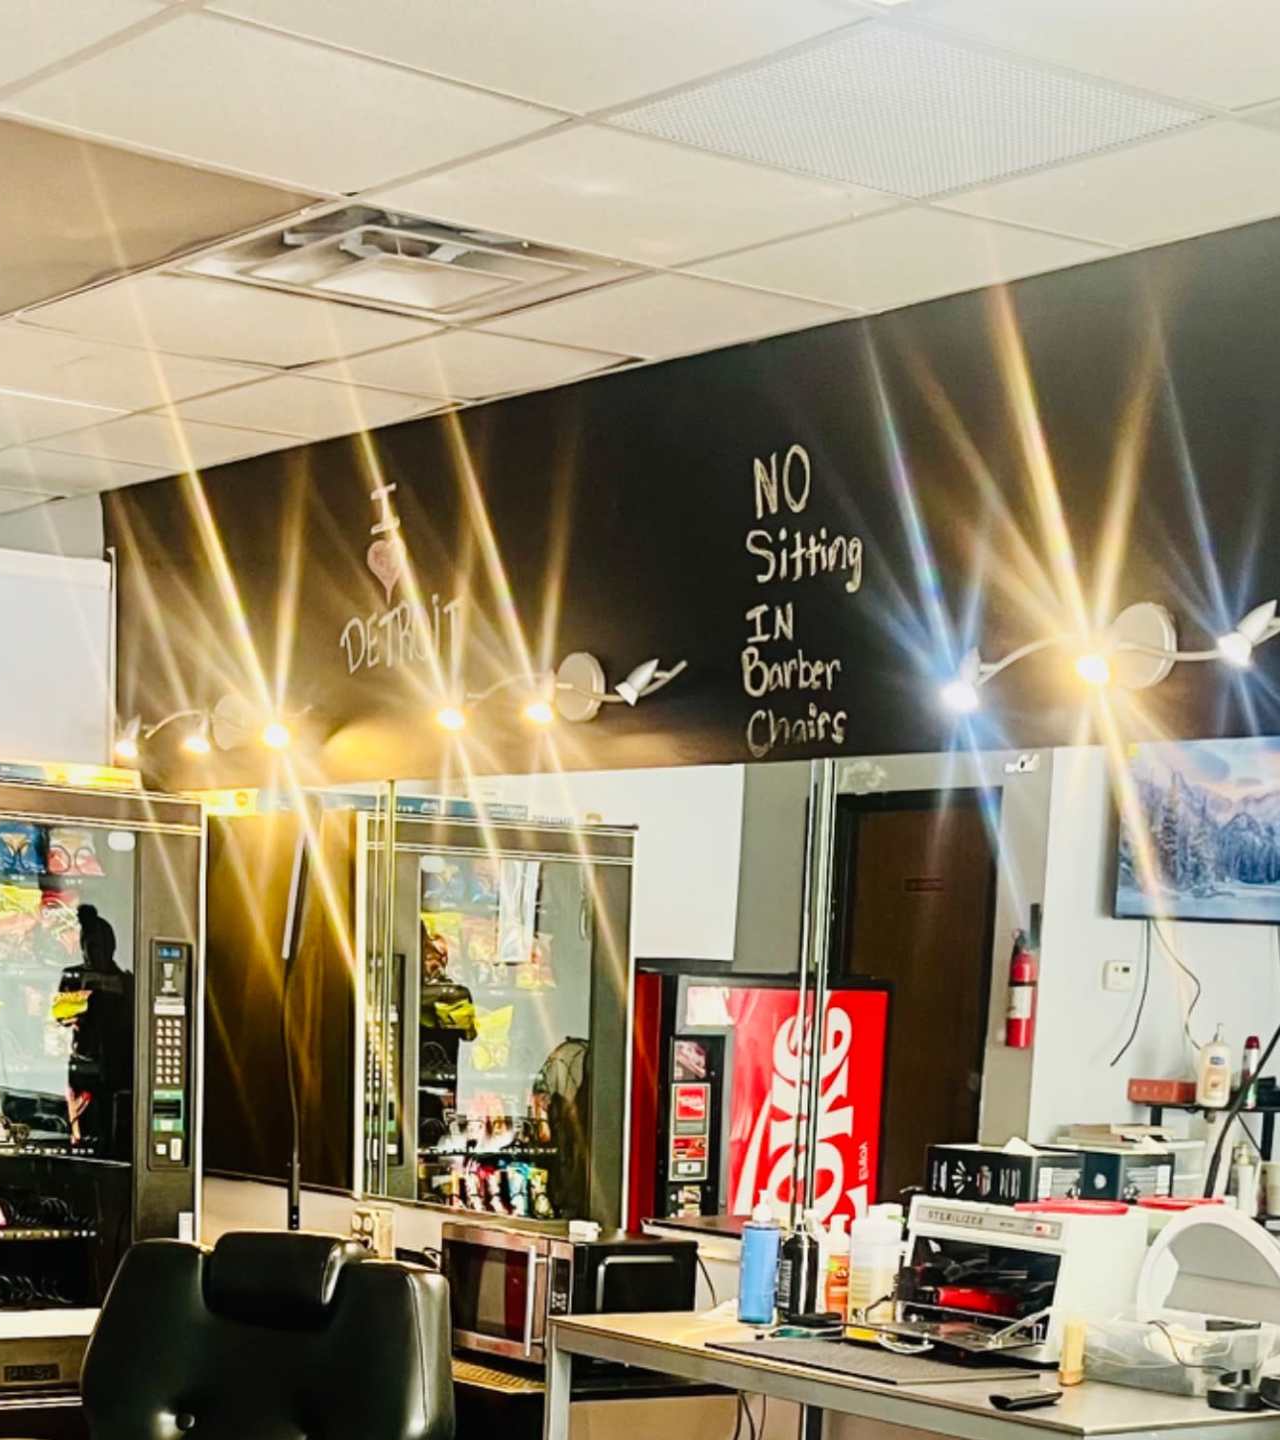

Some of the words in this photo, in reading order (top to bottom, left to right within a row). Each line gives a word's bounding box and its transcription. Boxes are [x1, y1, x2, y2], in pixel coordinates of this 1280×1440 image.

[371, 483, 400, 535] I
[753, 445, 810, 520] NO
[746, 528, 862, 593] Sitting
[745, 602, 793, 643] IN
[741, 646, 841, 697] Barber
[747, 702, 847, 758] Chairs
